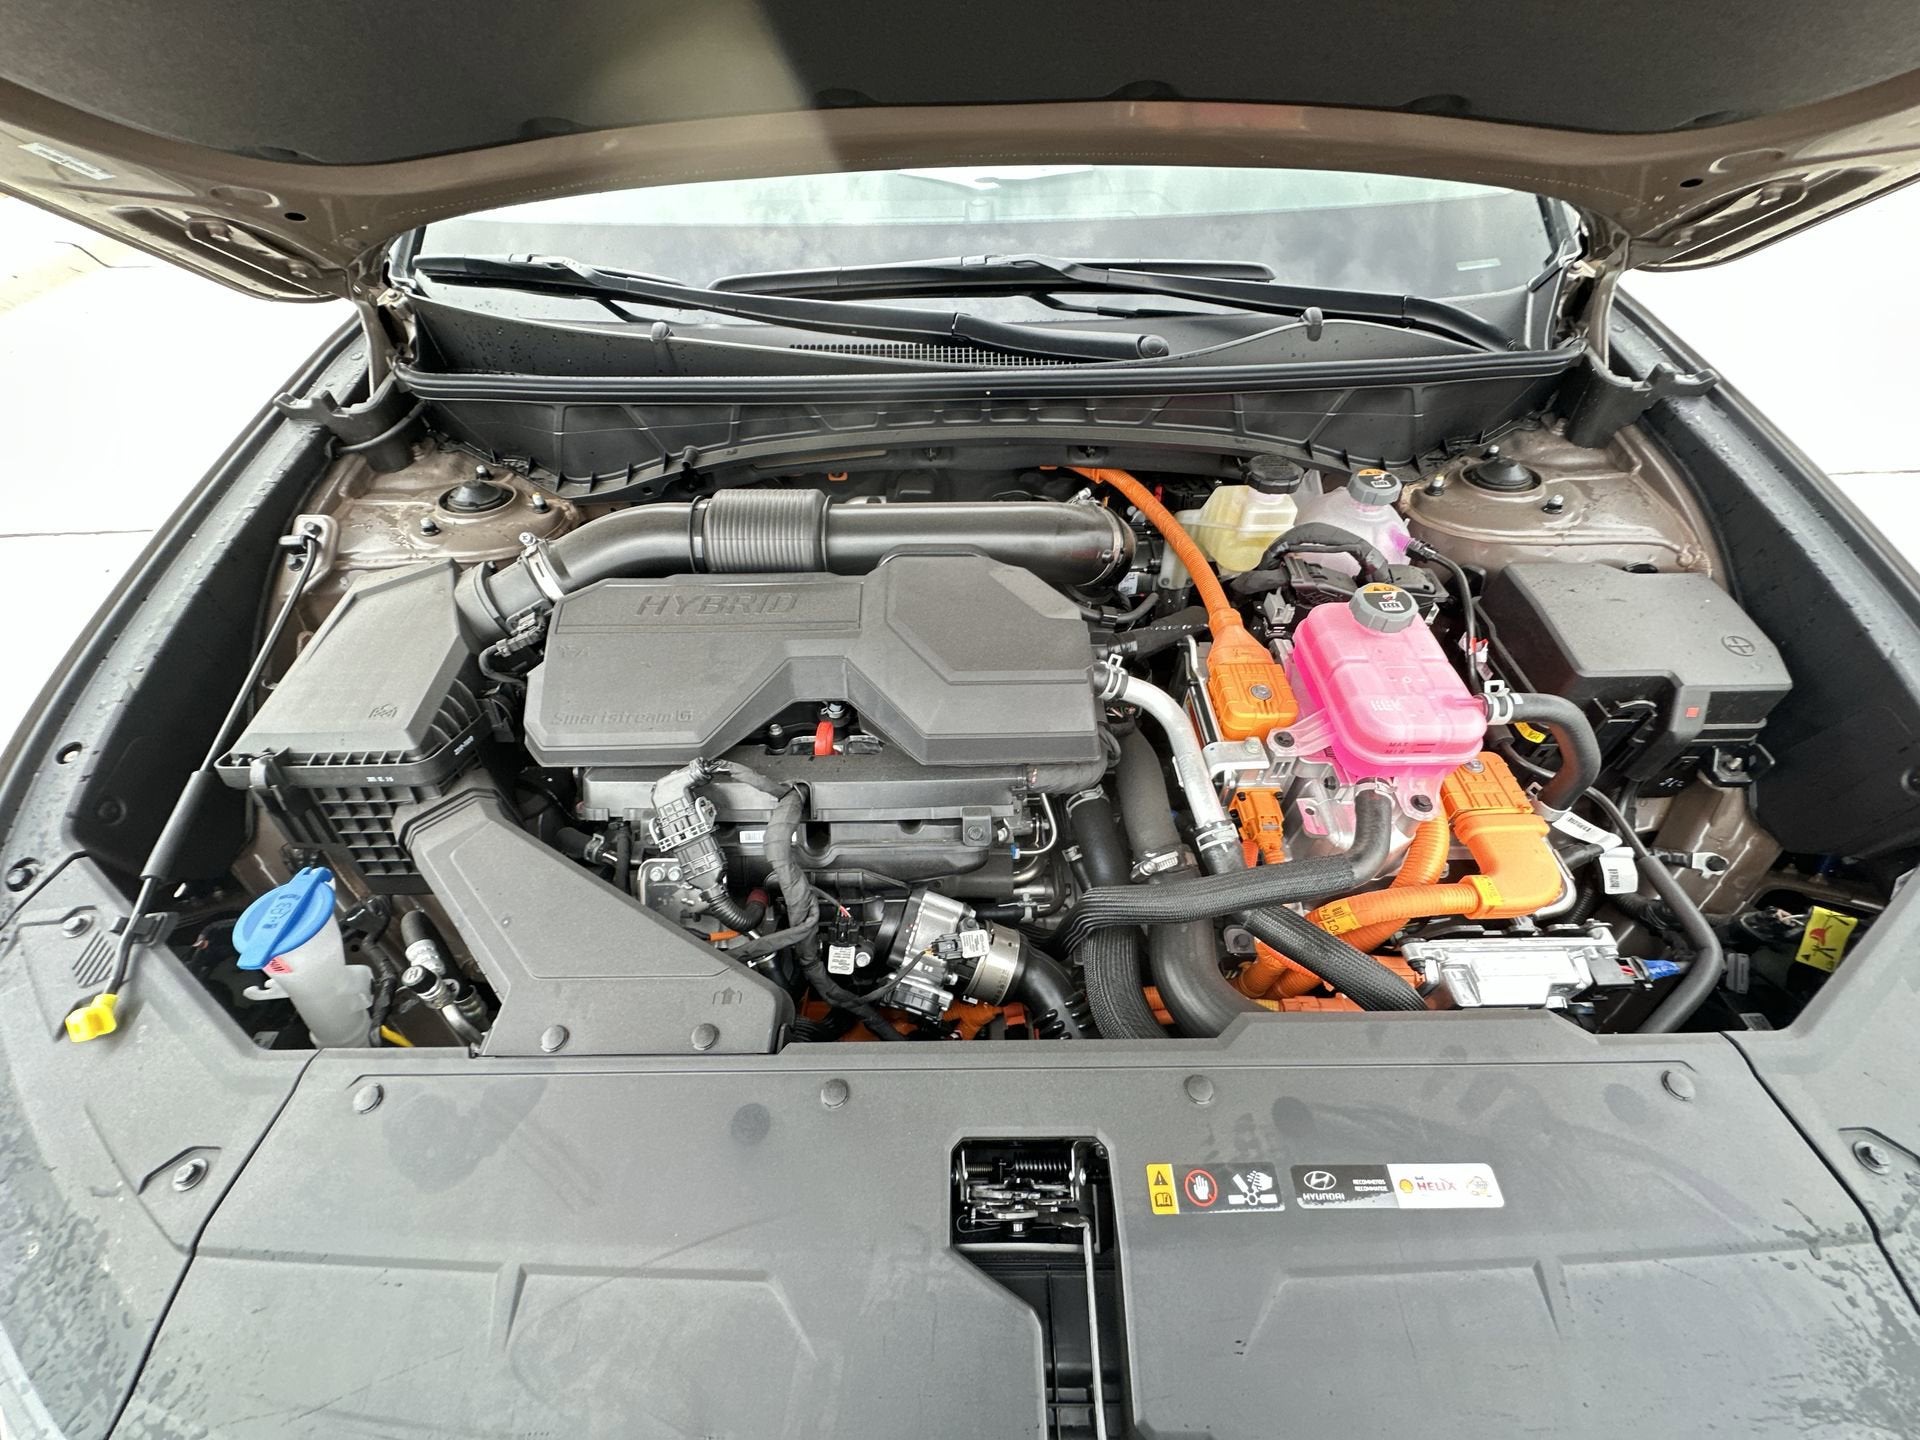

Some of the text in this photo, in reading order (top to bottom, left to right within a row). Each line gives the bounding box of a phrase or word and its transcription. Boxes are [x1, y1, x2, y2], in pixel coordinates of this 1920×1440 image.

[634, 593, 798, 616] HYBRID
[1416, 1181, 1457, 1191] HELIX
[1302, 1192, 1345, 1201] HYUNDAI
